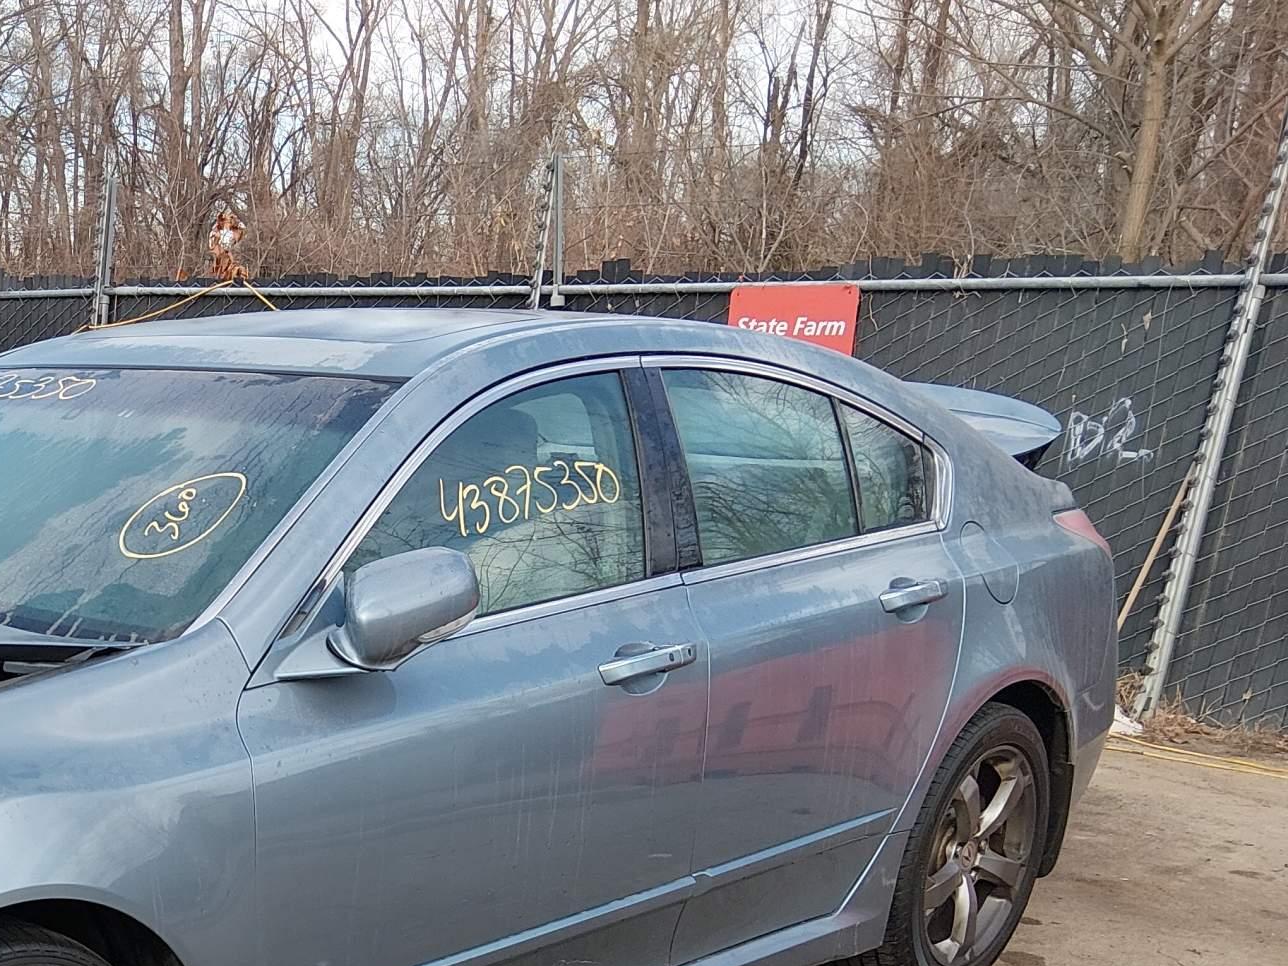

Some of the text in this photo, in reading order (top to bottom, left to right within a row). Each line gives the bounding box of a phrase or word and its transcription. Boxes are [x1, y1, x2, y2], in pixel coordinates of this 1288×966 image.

[738, 316, 845, 336] State Farm
[439, 460, 621, 537] 43875350
